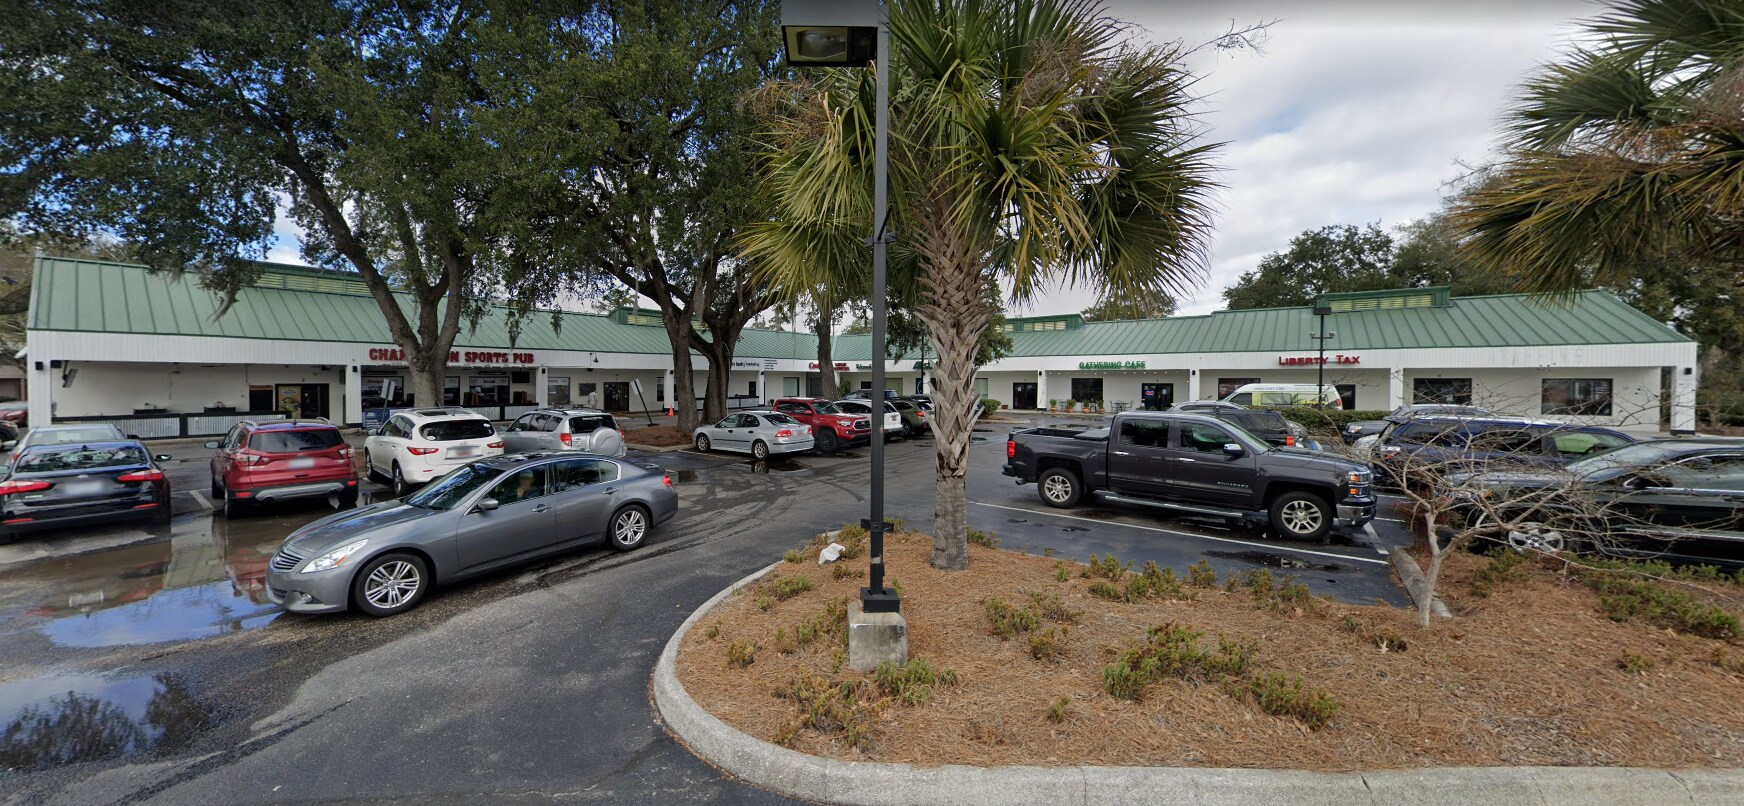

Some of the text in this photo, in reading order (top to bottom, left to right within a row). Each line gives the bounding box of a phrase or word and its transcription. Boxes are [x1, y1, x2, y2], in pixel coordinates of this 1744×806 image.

[368, 347, 535, 364] CHAN SPORTS PUB
[1079, 360, 1147, 370] GATHERING CAFE
